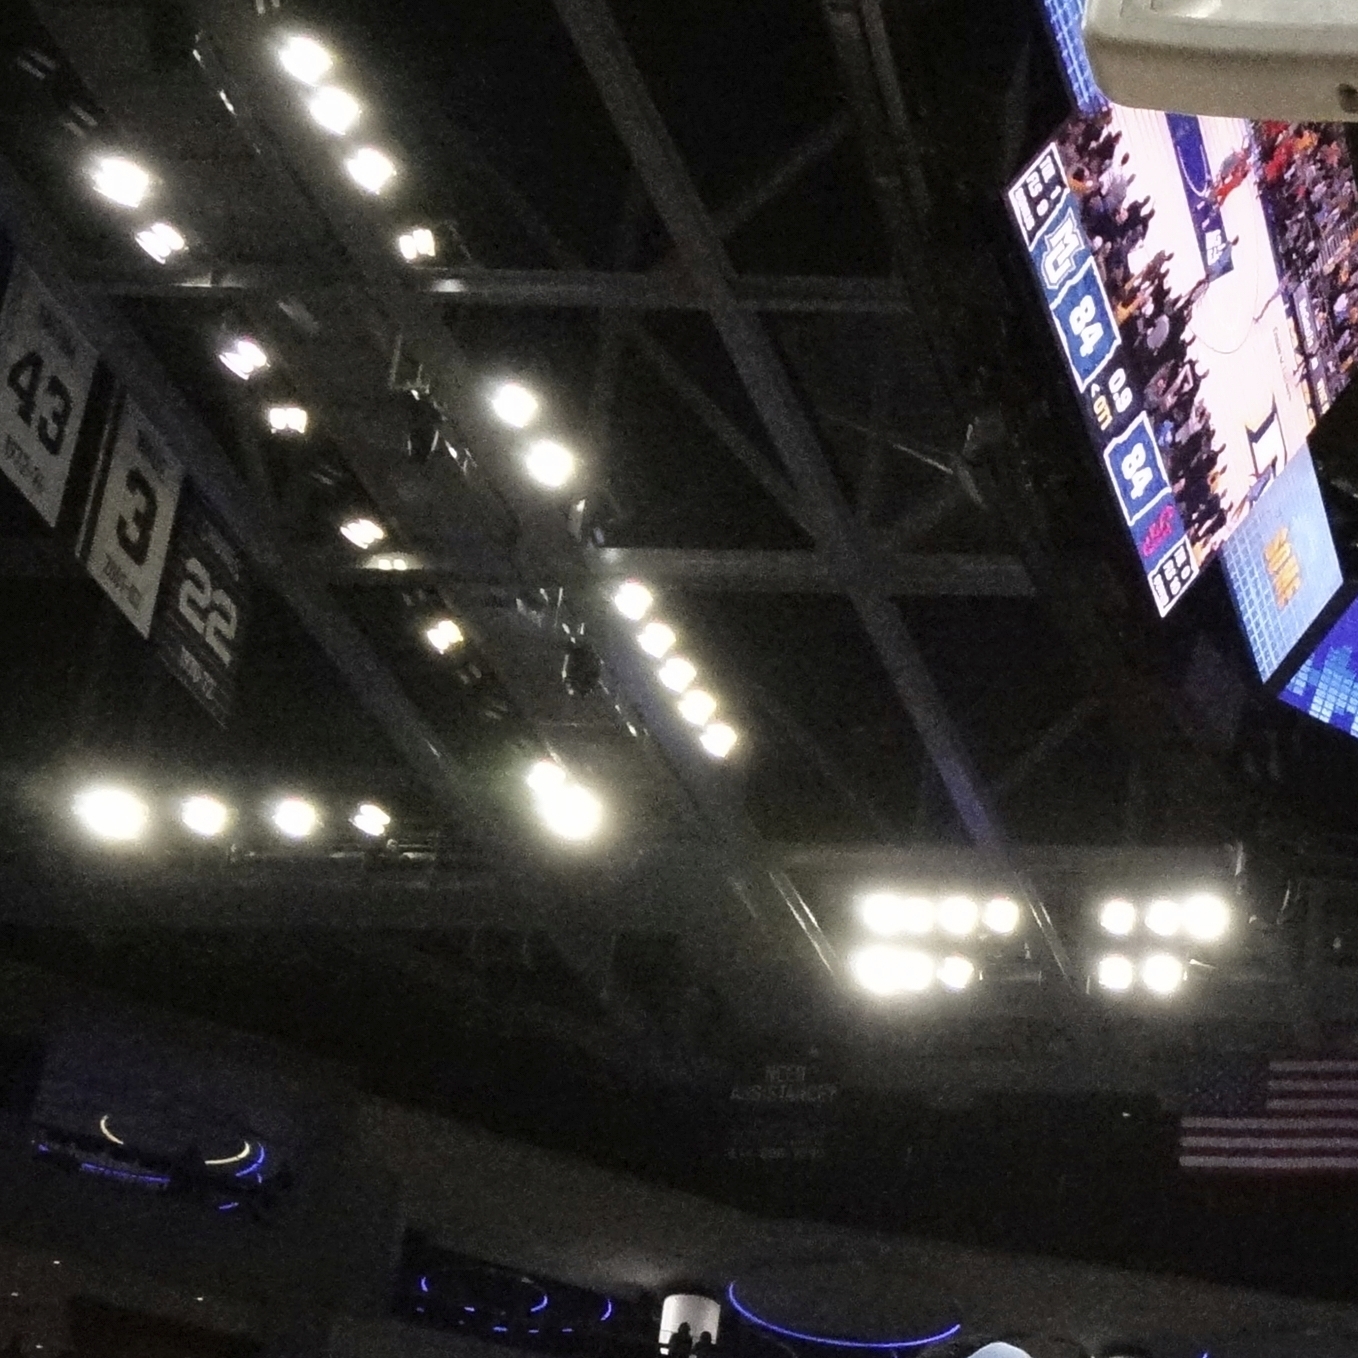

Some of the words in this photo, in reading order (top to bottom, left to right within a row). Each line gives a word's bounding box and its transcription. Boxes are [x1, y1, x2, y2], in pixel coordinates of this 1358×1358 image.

[1069, 294, 1104, 358] 84
[7, 351, 73, 456] 43
[116, 466, 158, 567] 3
[1120, 442, 1154, 500] 84
[178, 556, 238, 668] 22
